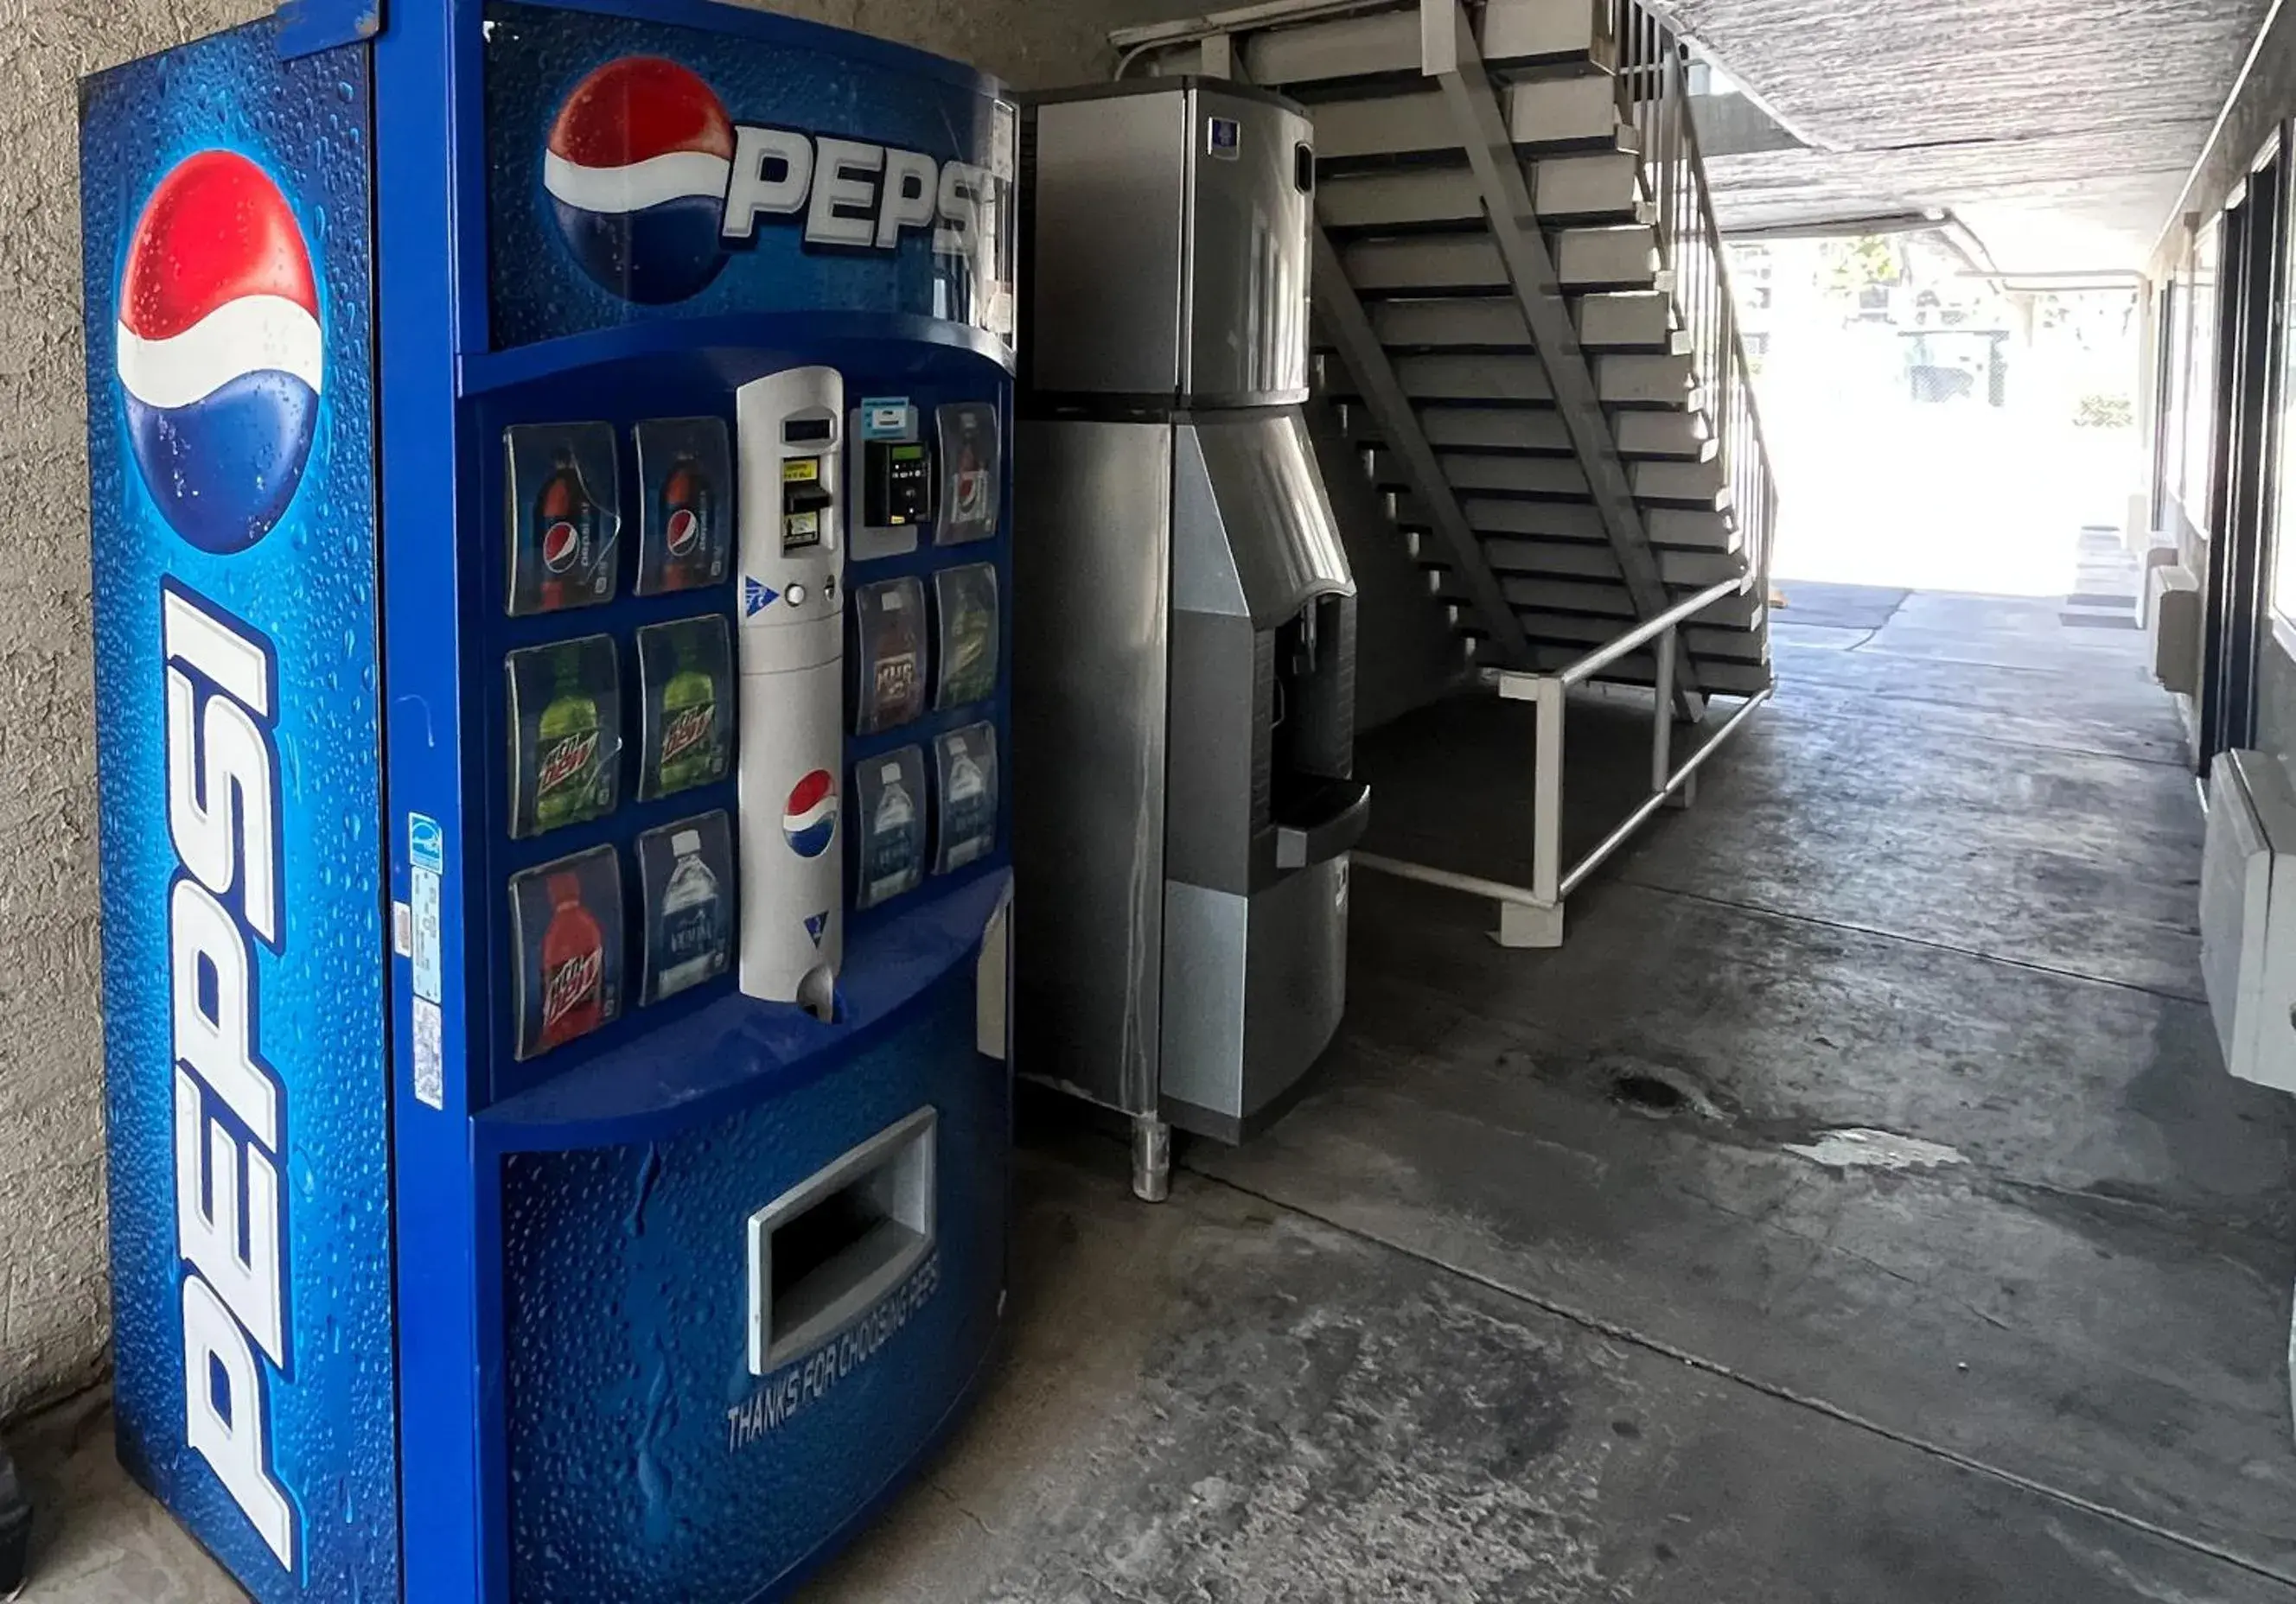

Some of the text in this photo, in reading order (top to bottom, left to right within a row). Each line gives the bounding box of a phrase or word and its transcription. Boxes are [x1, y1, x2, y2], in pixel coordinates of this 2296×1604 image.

[163, 589, 292, 1574] PEPSI
[727, 1369, 801, 1455] THANKS
[802, 1343, 837, 1405] FOR
